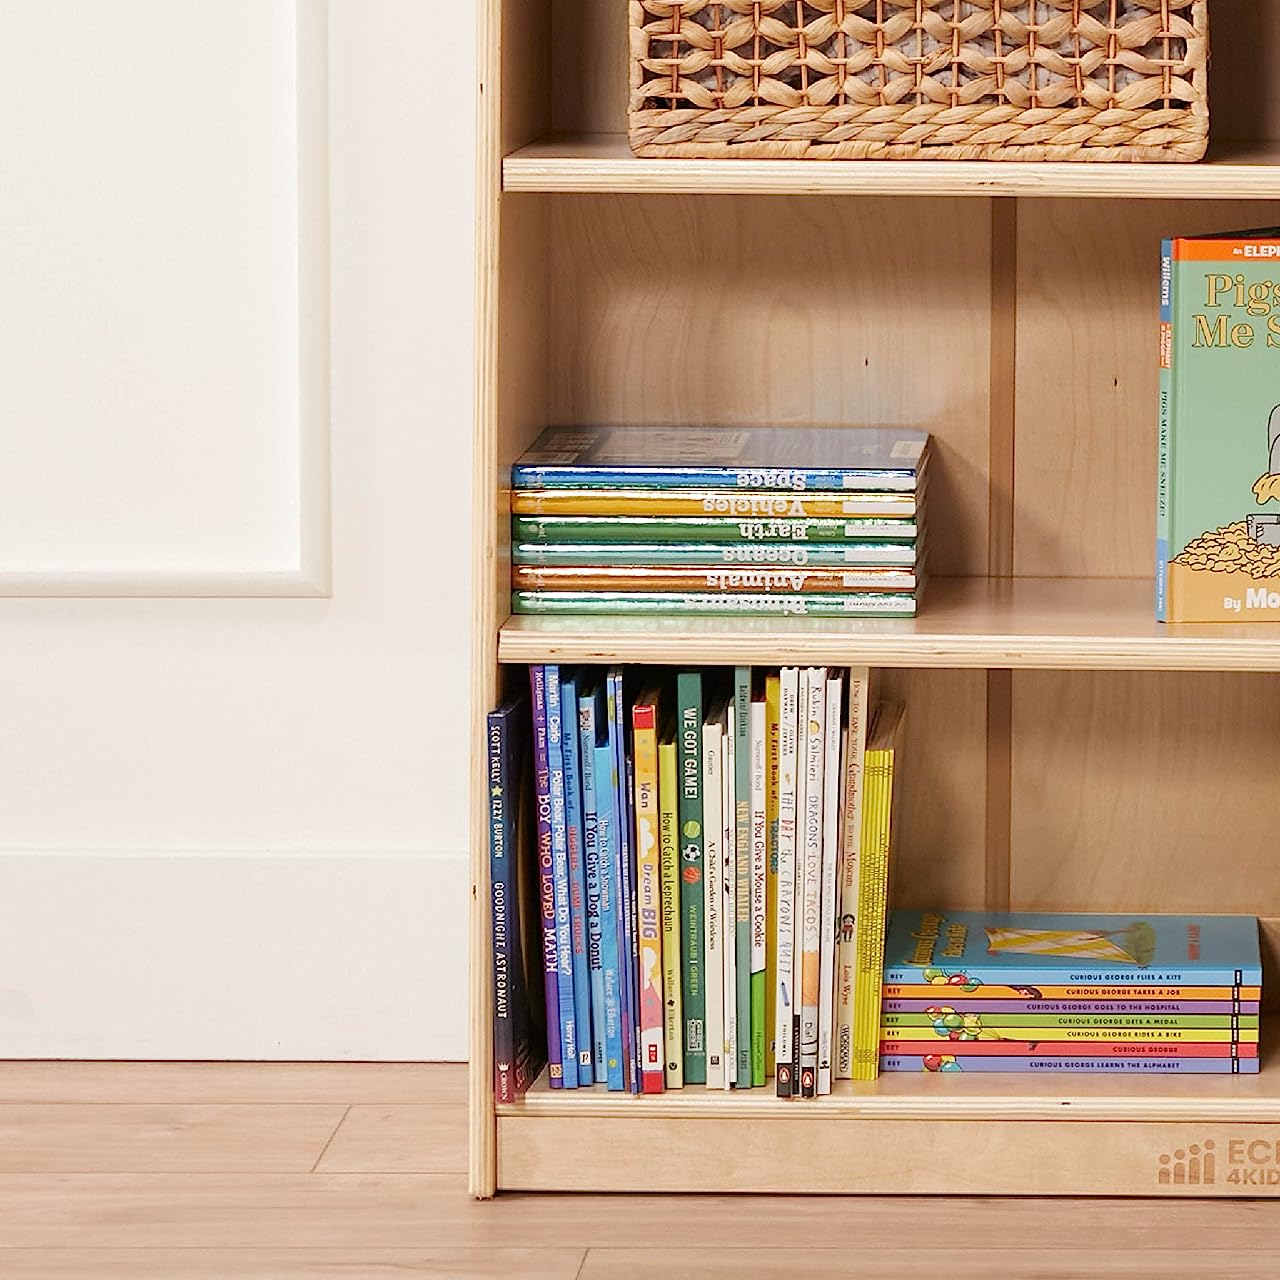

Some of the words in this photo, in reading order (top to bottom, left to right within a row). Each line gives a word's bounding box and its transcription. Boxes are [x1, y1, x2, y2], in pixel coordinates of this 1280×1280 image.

[1160, 256, 1171, 306] Willems
[1192, 314, 1255, 348] Me
[736, 474, 808, 491] Space
[702, 499, 808, 516] Vehicles
[738, 523, 809, 540] Earth
[722, 549, 809, 565] Oceans
[706, 574, 808, 591] Animals
[1223, 597, 1241, 613] By
[810, 686, 822, 717] Rubin
[683, 707, 697, 728] WE
[490, 726, 502, 754] SCOTT
[683, 730, 697, 756] GOT
[491, 756, 502, 784] KELLY
[809, 737, 821, 782] Salmieri
[539, 768, 549, 788] The
[552, 770, 564, 796] Polar
[684, 759, 698, 799] GAME!
[640, 782, 651, 808] Wan
[492, 799, 502, 820] IZZY
[538, 794, 550, 824] BOY
[553, 798, 566, 823] Bear,
[585, 811, 597, 822] If
[662, 812, 673, 831] How
[754, 811, 765, 820] If
[808, 796, 819, 848] DRAGONS
[493, 823, 504, 858] BURTON
[554, 825, 566, 850] Polar
[586, 825, 598, 848] You
[665, 834, 673, 844] to
[754, 822, 764, 838] You
[540, 831, 553, 868] WHO
[662, 846, 674, 871] Catch
[754, 841, 764, 862] Give
[556, 854, 567, 877] Bear,
[587, 852, 599, 878] Give
[806, 855, 817, 885] LOVE
[542, 874, 554, 920] LOVED
[557, 878, 569, 906] What
[643, 864, 654, 905] Dream
[754, 873, 764, 904] Mouse
[559, 907, 570, 921] Do
[587, 894, 600, 918] Dog
[662, 880, 675, 932] Leprechaun
[805, 890, 818, 932] TACOS
[559, 924, 571, 943] You
[642, 908, 657, 938] BIG
[689, 905, 698, 958] WEINTRAUB
[754, 914, 765, 948] Cookie
[544, 927, 557, 973] MATH
[560, 945, 572, 976] Hear?
[590, 932, 603, 971] Donut
[690, 966, 699, 996] GREEN
